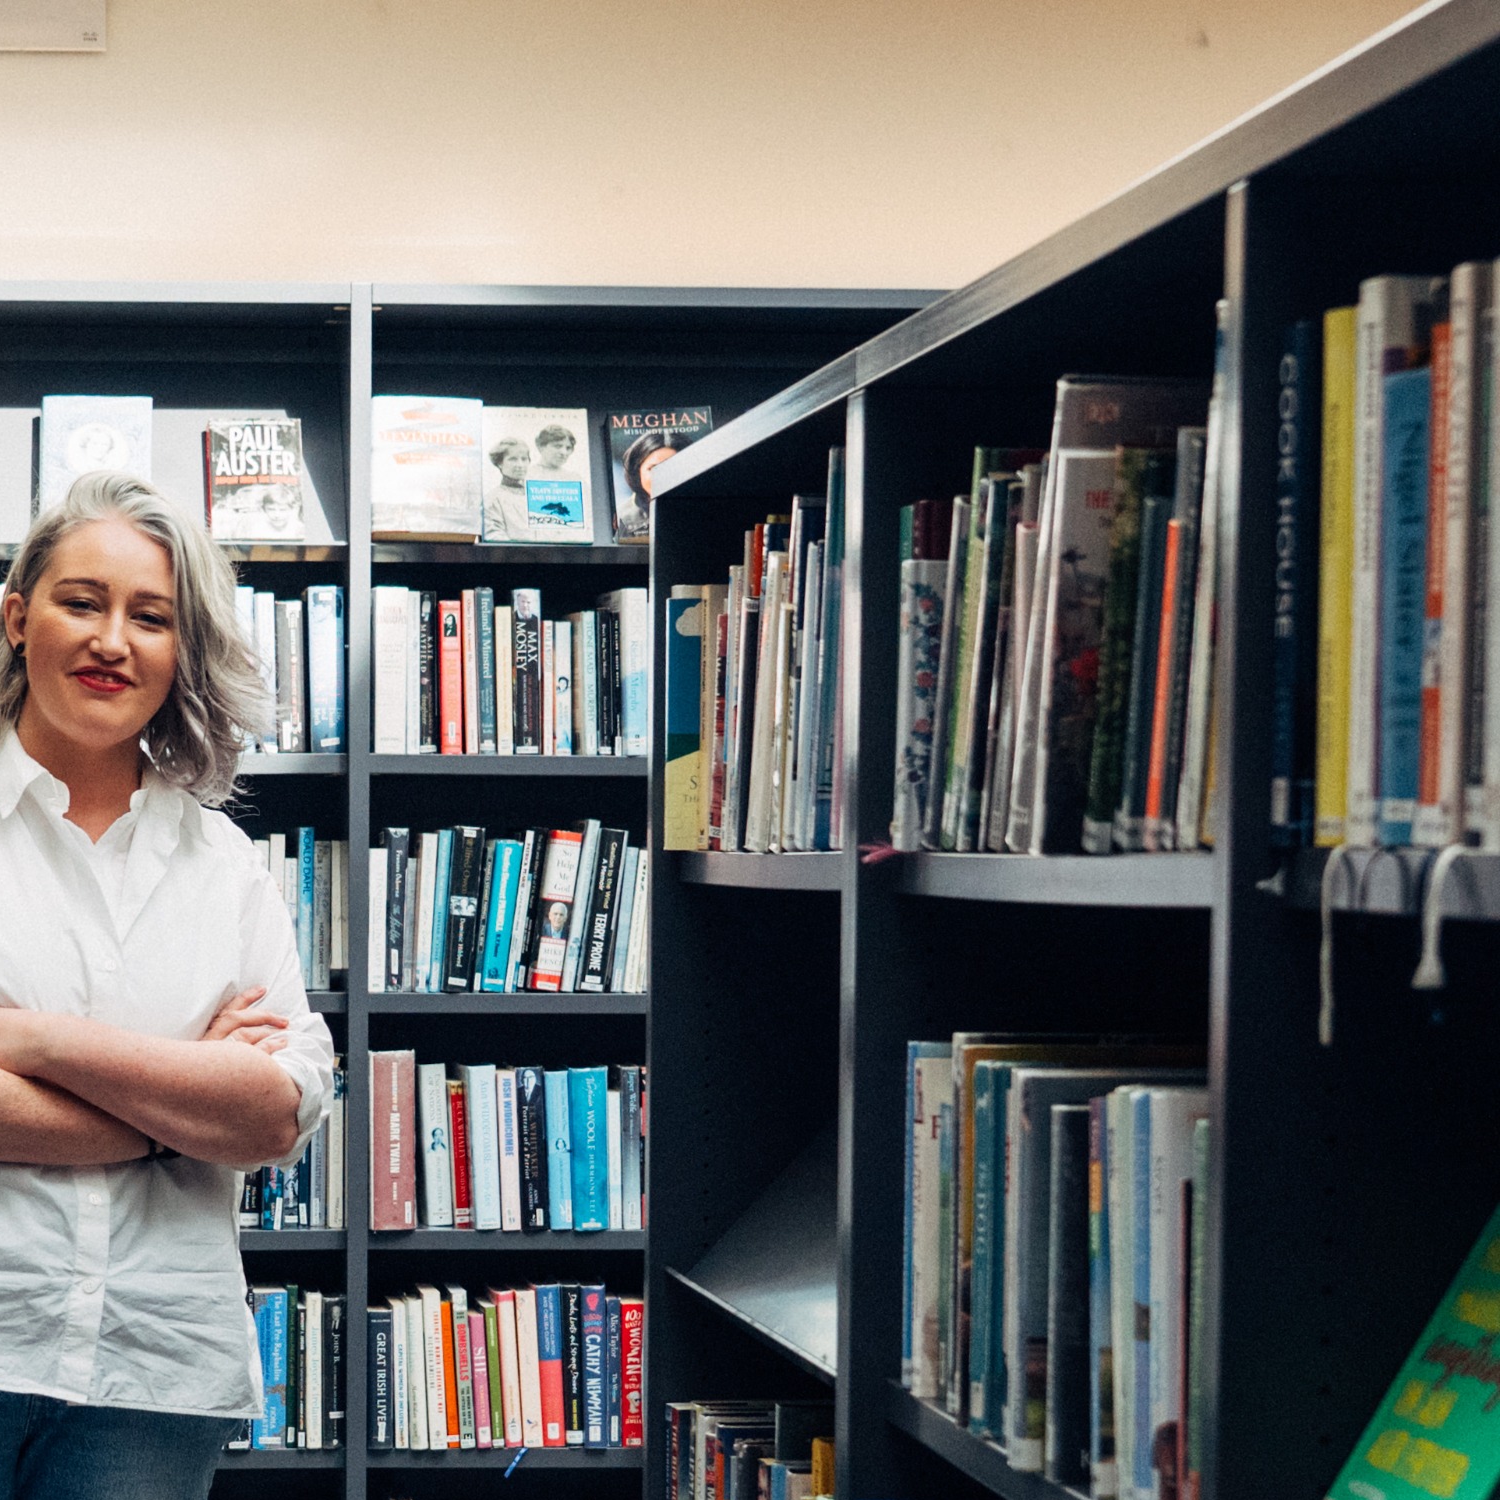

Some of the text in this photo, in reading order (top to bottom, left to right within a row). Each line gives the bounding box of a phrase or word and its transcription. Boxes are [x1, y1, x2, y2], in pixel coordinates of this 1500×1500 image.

[229, 426, 284, 451] PAUL
[612, 411, 708, 429] MEGHAN
[215, 451, 297, 477] AUSTER
[1273, 352, 1299, 639] COOK HOUSE
[420, 624, 428, 673] MAYFIELD
[480, 597, 493, 679] Ireland's Minstrel
[515, 622, 528, 671] MOSLEY
[527, 631, 537, 662] MAX
[303, 829, 313, 895] ROALD DAHL
[588, 913, 608, 971] TERRY PRONE
[522, 1104, 531, 1135] Portrait
[586, 1110, 596, 1151] WOOLF
[389, 1113, 401, 1174] MARK TWAIN
[524, 1153, 532, 1180] Patriot
[376, 1332, 387, 1366] GREAT
[456, 1323, 470, 1382] BOMBSHELLS
[609, 1312, 620, 1359] Alice Taylor
[626, 1327, 642, 1376] WOMEN
[376, 1368, 387, 1396] IRISH
[473, 1346, 487, 1379] SHE
[585, 1334, 602, 1427] CATHY NEWMAN
